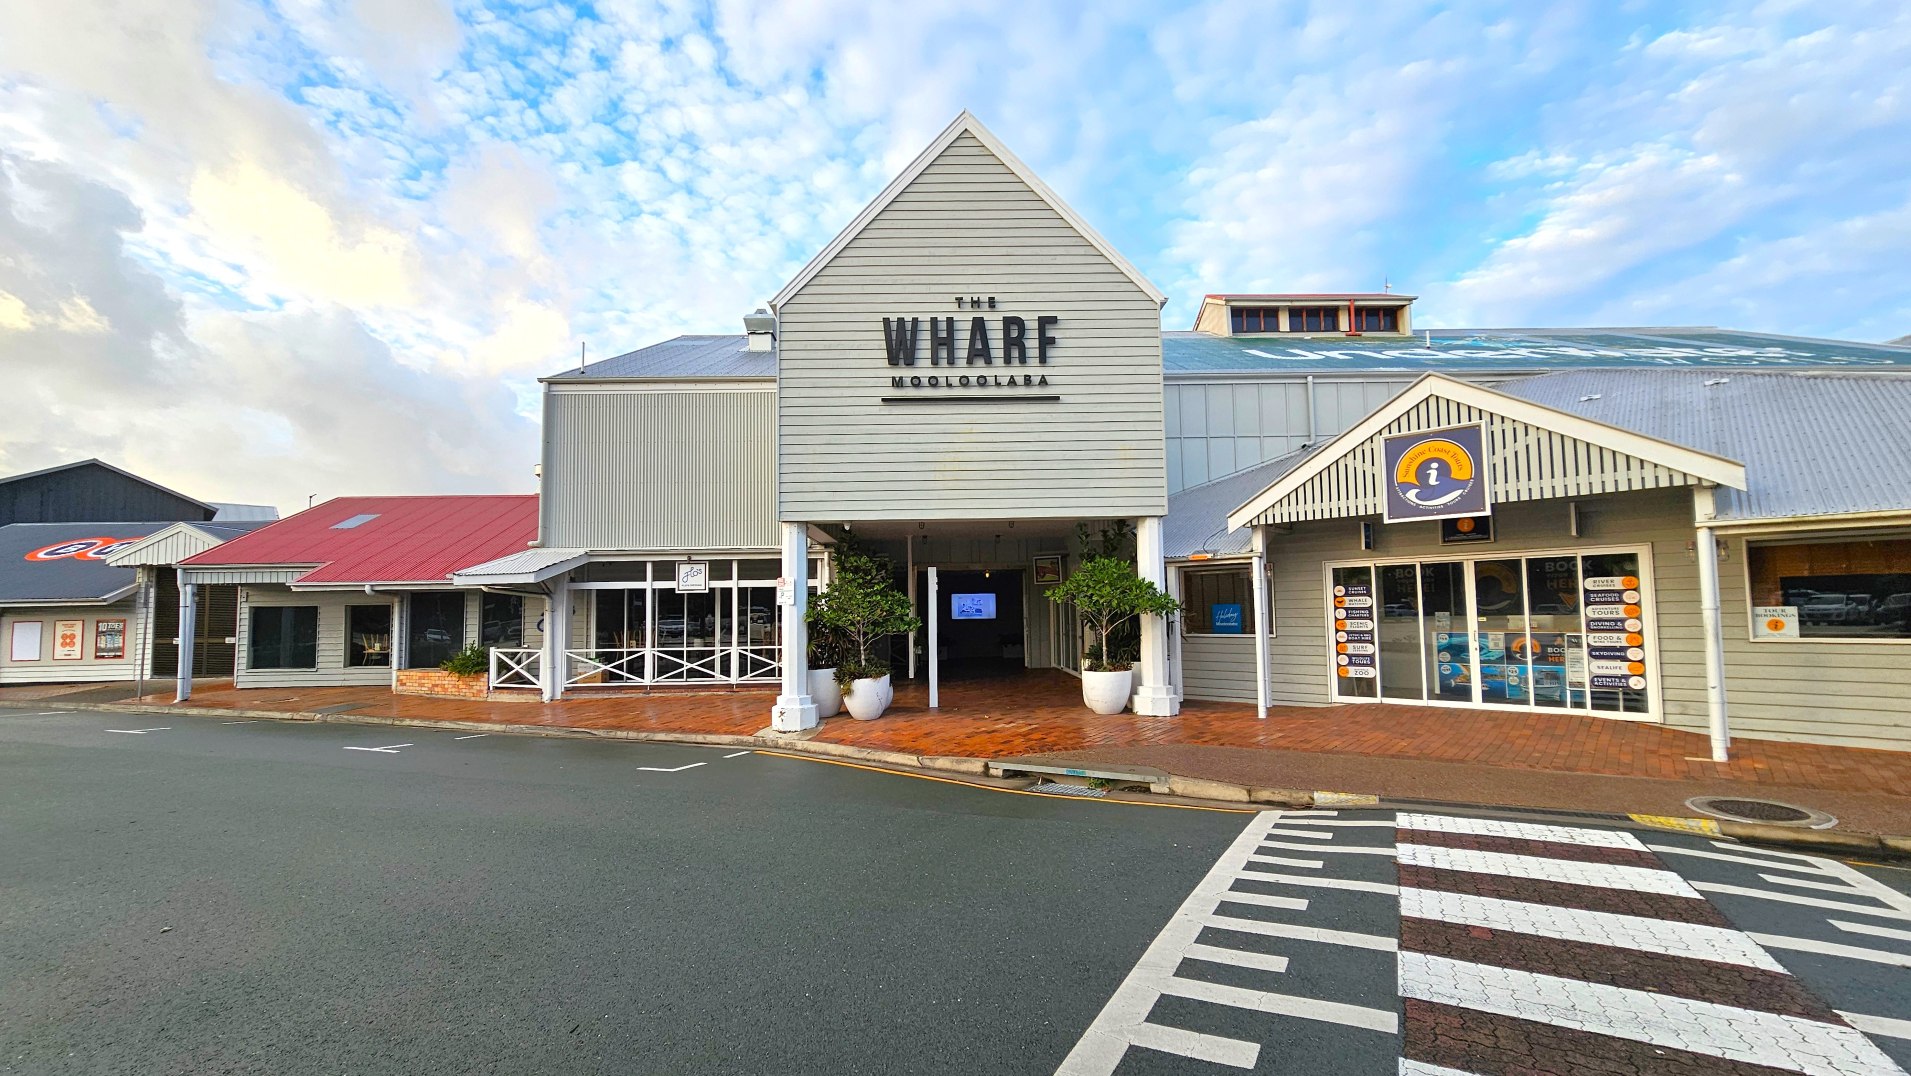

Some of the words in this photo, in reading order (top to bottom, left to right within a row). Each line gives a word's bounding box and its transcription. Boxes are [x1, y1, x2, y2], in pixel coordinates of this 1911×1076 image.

[955, 296, 996, 309] THE
[882, 315, 1058, 365] WHARF
[891, 374, 1049, 387] MOOLOOLABA
[1402, 449, 1426, 479] Sunshine
[1428, 445, 1451, 455] Coast
[1450, 452, 1464, 472] Tours
[1446, 496, 1462, 506] TOURS
[1395, 567, 1434, 578] BOK
